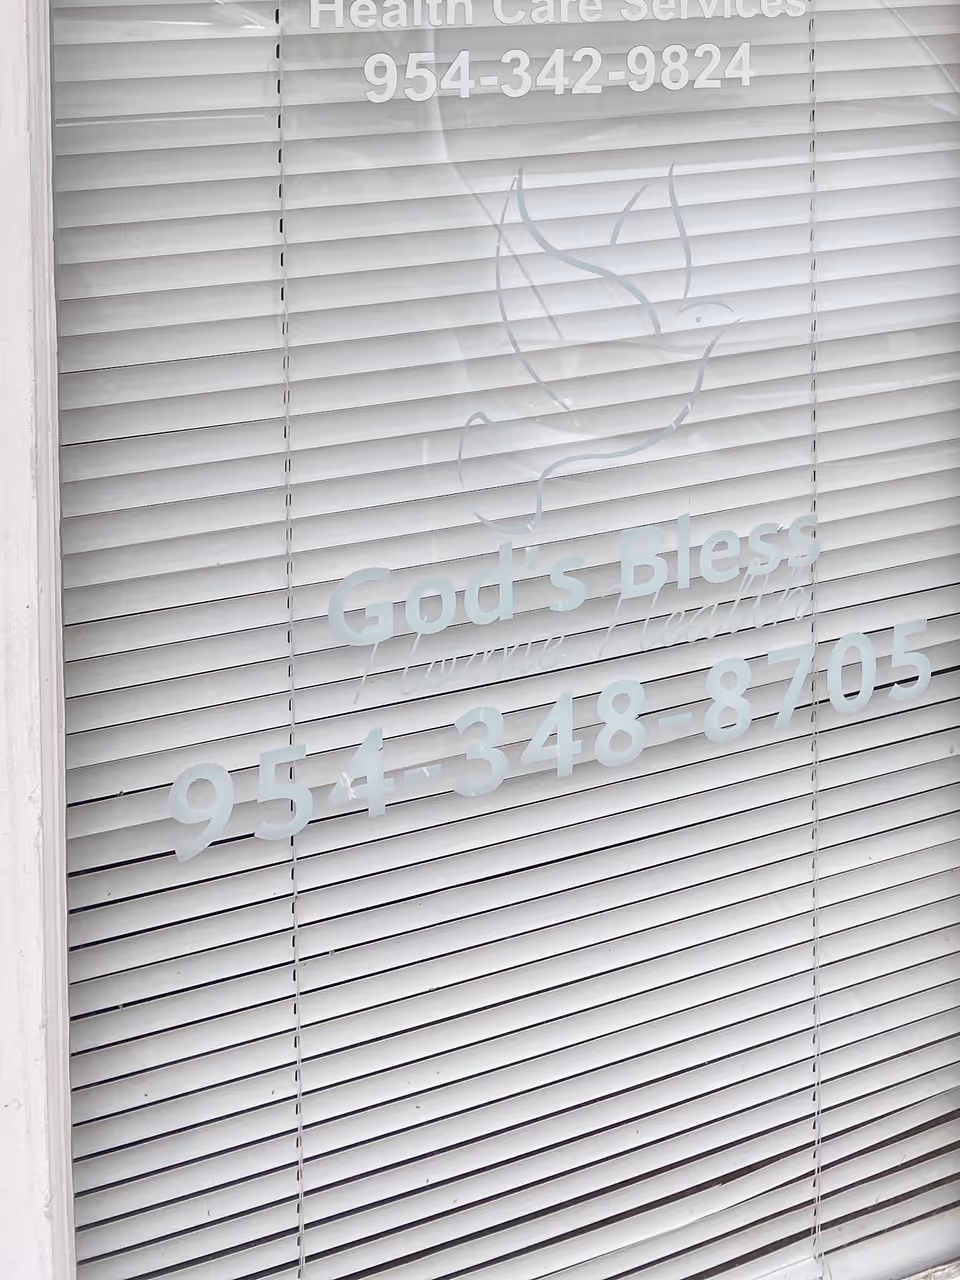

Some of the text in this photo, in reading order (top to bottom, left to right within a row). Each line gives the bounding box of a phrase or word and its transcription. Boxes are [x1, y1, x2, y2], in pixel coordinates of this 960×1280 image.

[362, 40, 755, 104] 954-342-9824
[327, 513, 823, 647] God's Bless
[168, 618, 932, 863] 954-348-8705
